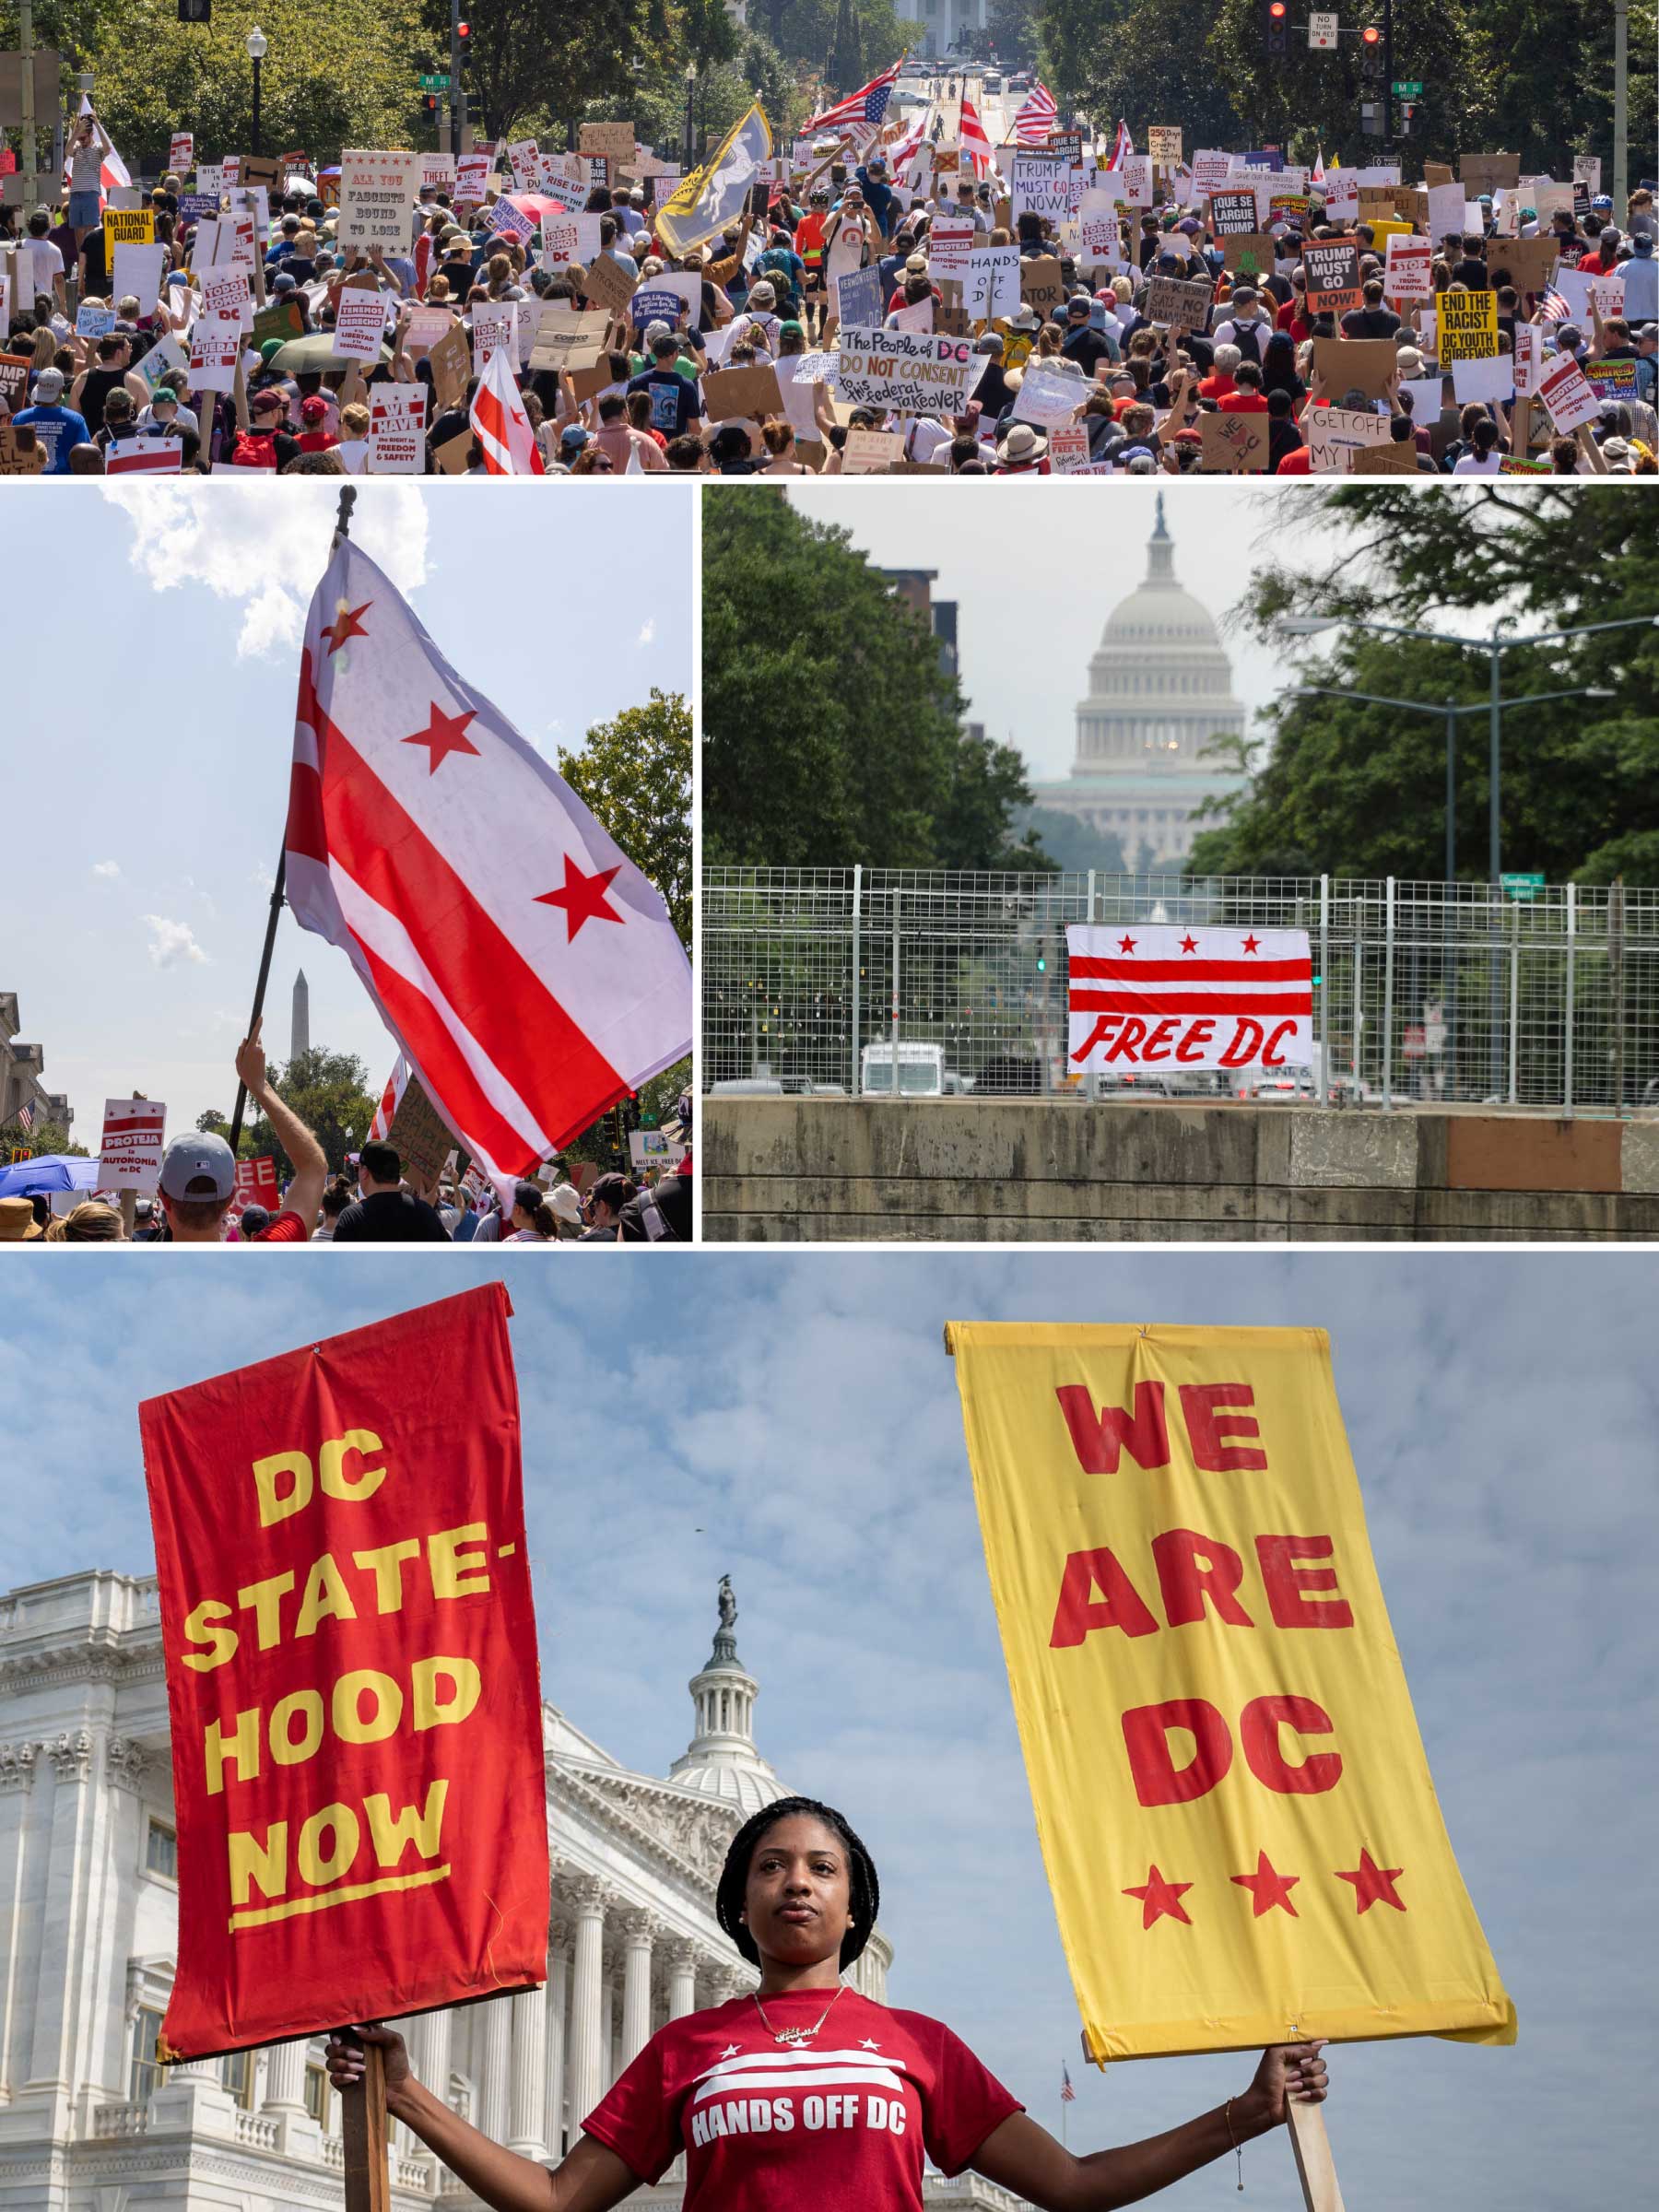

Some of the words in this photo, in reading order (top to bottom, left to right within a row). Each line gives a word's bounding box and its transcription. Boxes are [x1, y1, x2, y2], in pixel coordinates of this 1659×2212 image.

[1317, 16, 1330, 24] NO
[1069, 136, 1080, 145] SE
[1150, 129, 1166, 137] 250
[1167, 129, 1181, 140] Days
[1150, 140, 1176, 148] Cruelty
[1150, 151, 1182, 160] Stupidity
[1016, 162, 1062, 178] TRUMP
[1124, 168, 1145, 180] TODOS
[351, 175, 375, 186] ALL
[380, 175, 403, 186] YOU
[422, 171, 449, 183] THEFT
[658, 179, 675, 188] THE
[1124, 177, 1145, 189] SOMOS
[546, 175, 568, 190] RISE
[571, 183, 585, 194] UP
[1016, 181, 1052, 194] MUST
[1053, 181, 1067, 194] GO
[1327, 182, 1357, 195] FUERA
[347, 191, 406, 204] FASCISTS
[539, 188, 569, 201] AGAINST
[570, 197, 583, 207] THE
[1129, 188, 1139, 197] DC
[1026, 194, 1069, 214] NOW!
[1213, 196, 1239, 211] ¡QUE
[1241, 195, 1253, 207] SE
[107, 212, 151, 227] NATIONAL
[355, 208, 396, 219] BOUND
[1215, 208, 1253, 221] LARGUE
[350, 225, 365, 236] TO
[371, 225, 401, 236] LOSE
[517, 216, 535, 234] FREE
[1082, 223, 1117, 236] TODOS
[1217, 222, 1253, 234] TRUMP
[113, 227, 145, 241] GUARD
[546, 229, 577, 241] TODOS
[1082, 233, 1117, 245] SOMOS
[546, 240, 578, 251] SOMOS
[933, 243, 971, 252] PROTEJA
[1092, 245, 1110, 256] DC
[553, 252, 570, 262] DC
[971, 254, 1019, 269] HANDS
[1305, 247, 1356, 264] TRUMP
[1311, 261, 1352, 276] MUST
[1395, 260, 1427, 271] STOP
[840, 269, 877, 290] VERMONTERS
[1153, 278, 1170, 291] THIS
[1322, 276, 1344, 289] GO
[206, 279, 247, 298] TODOS
[1392, 284, 1428, 292] TAKEOVER
[206, 292, 249, 310] SOMOS
[638, 300, 658, 310] Justice
[658, 300, 668, 309] for
[1183, 299, 1204, 312] NO
[1316, 291, 1357, 308] NOW!
[1441, 294, 1465, 312] END
[1468, 293, 1491, 312] THE
[218, 308, 241, 321] DC
[341, 307, 383, 315] TENEMOS
[643, 308, 679, 317] Exceptions
[339, 318, 382, 326] DERECHO
[1445, 312, 1489, 330] RACIST
[341, 332, 374, 342] LIBERTAD
[1442, 334, 1459, 348] DC
[1459, 332, 1493, 348] YOUTH
[194, 343, 236, 355] FUERA
[339, 343, 373, 352] SEGURIDAD
[842, 332, 872, 350] The
[872, 332, 919, 357] People
[920, 339, 934, 359] of
[936, 340, 970, 363] DC
[1441, 347, 1495, 363] CURFEWS!
[203, 356, 222, 368] ICE
[840, 354, 864, 374] DO
[866, 356, 899, 378] NOT
[900, 360, 970, 387] CONSENT
[839, 376, 853, 392] to
[1548, 375, 1583, 404] PROTEJA
[847, 380, 871, 402] this
[384, 403, 409, 416] WE
[1574, 405, 1583, 413] DC
[378, 419, 418, 433] HAVE
[1218, 415, 1243, 440] WE
[1312, 410, 1349, 428] GET
[1352, 415, 1386, 435] OFF
[1236, 435, 1261, 459] DC
[1311, 444, 1338, 466] MY
[1070, 1015, 1217, 1064] FREE
[1217, 1017, 1298, 1068] DC
[105, 1134, 159, 1148] PROTEJA
[103, 1156, 158, 1167] AUTONOMÍA
[129, 1166, 141, 1174] DC
[1054, 1381, 1268, 1475] WE
[252, 1428, 388, 1529] DC
[1049, 1527, 1355, 1648] ARE
[181, 1522, 515, 1673] STATE-
[204, 1654, 481, 1795] HOOD
[1121, 1694, 1343, 1808] DC
[228, 1778, 450, 1906] NOW
[691, 2098, 794, 2147] HANDS
[802, 2094, 859, 2130] OFF
[866, 2094, 907, 2136] DC
